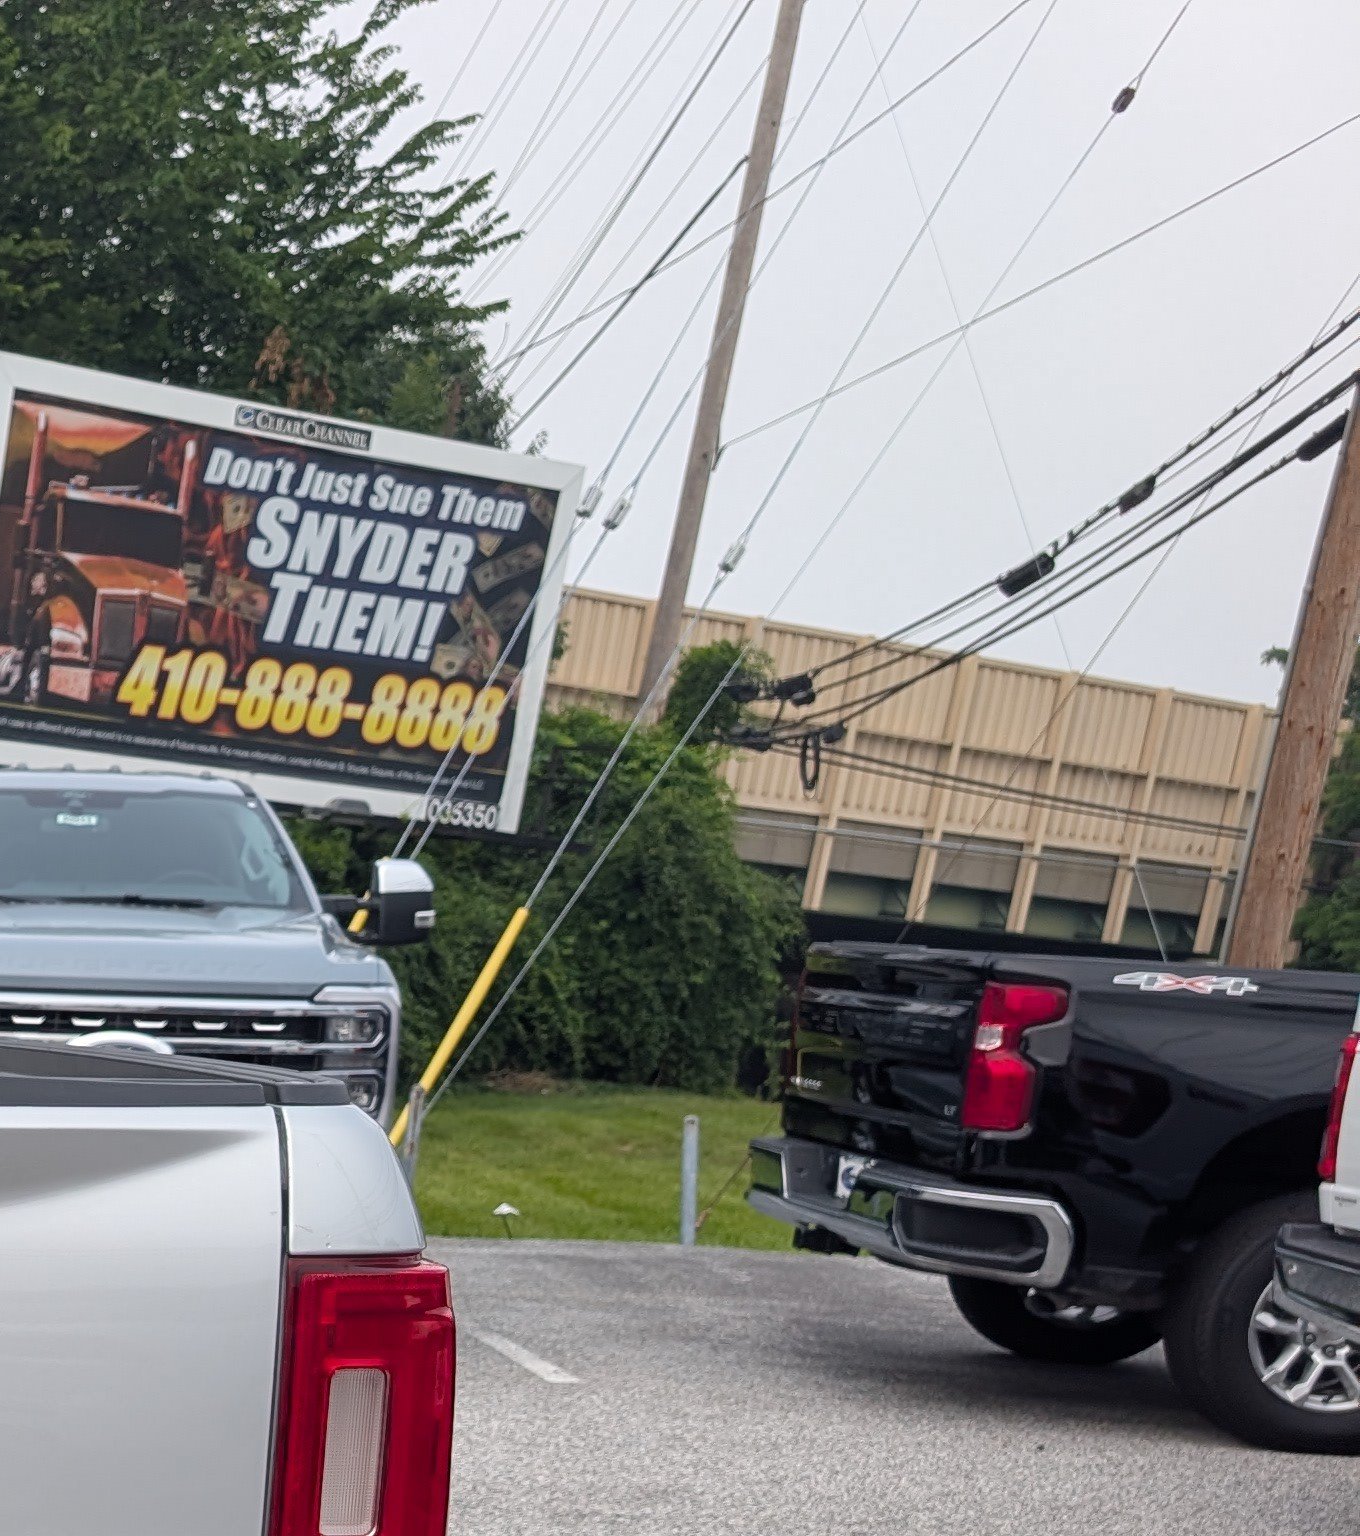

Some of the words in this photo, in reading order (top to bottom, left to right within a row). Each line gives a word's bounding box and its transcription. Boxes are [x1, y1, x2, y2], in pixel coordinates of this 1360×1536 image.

[204, 446, 295, 494] Don't
[294, 464, 367, 508] Just
[370, 475, 431, 517] Sue
[435, 483, 525, 532] Them
[247, 497, 477, 596] SNYDER
[264, 570, 446, 662] THEM!
[116, 643, 509, 756] 410-888-8888
